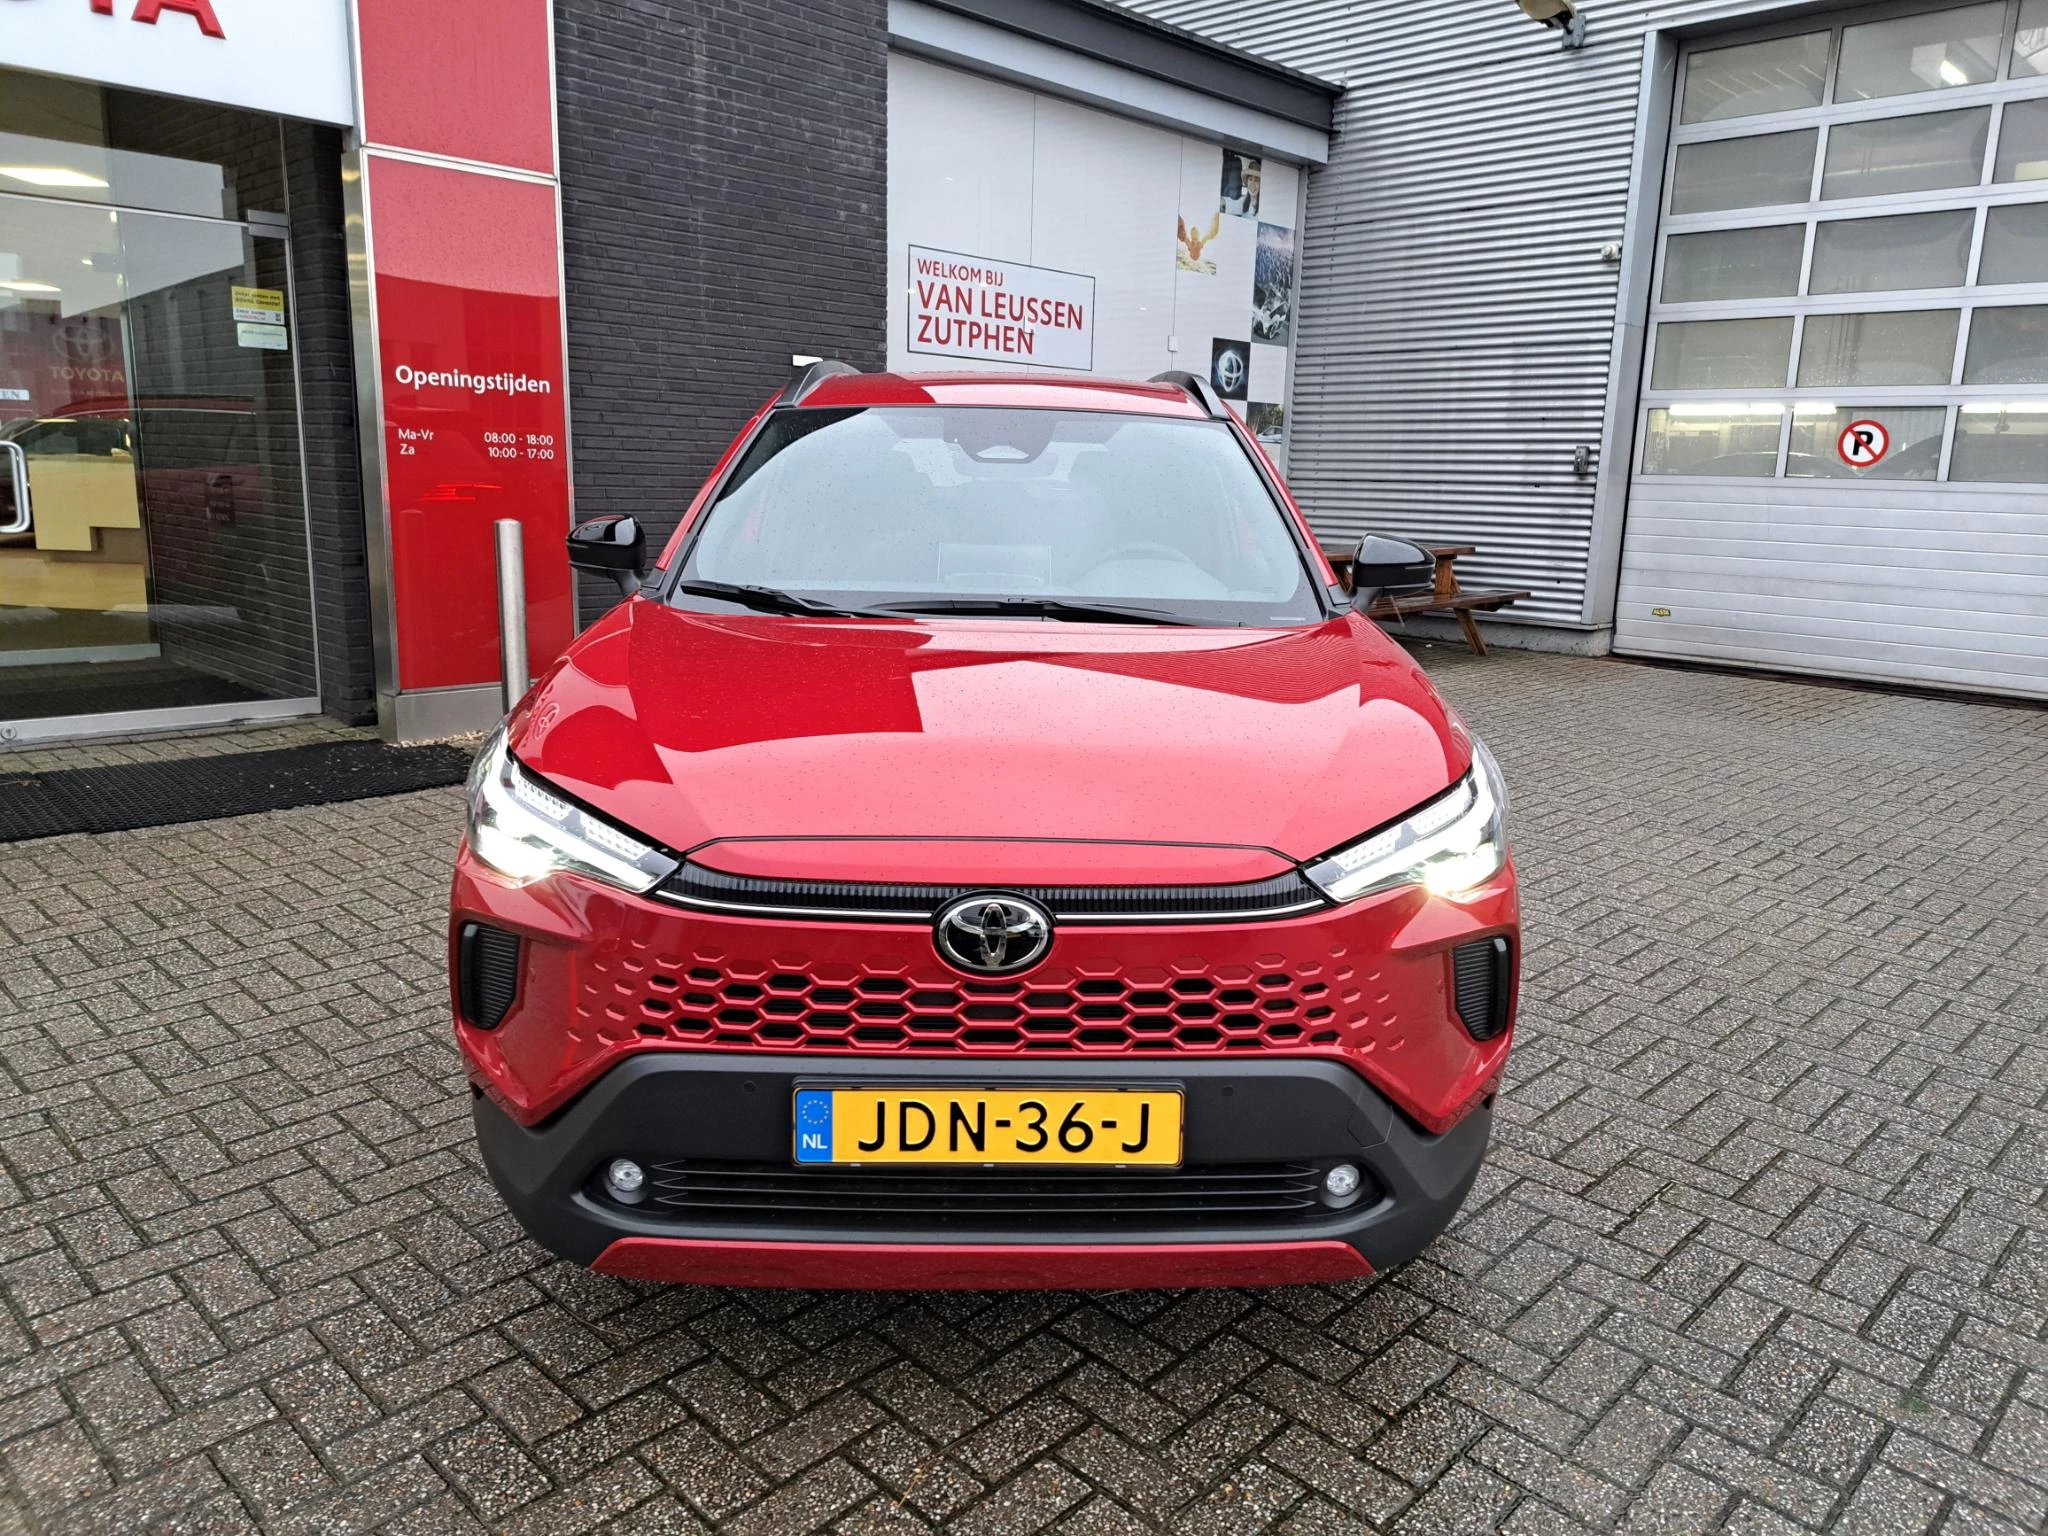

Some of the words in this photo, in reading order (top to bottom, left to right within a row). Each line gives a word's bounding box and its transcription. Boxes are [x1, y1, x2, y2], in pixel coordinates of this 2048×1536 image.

[917, 258, 982, 283] WELKOM
[986, 270, 1004, 287] BIJ
[917, 280, 972, 315] VAN
[981, 290, 1083, 330] LEUSSEN
[917, 314, 1033, 355] ZUTPHEN
[49, 366, 125, 383] TOYOTA
[395, 365, 550, 396] Openingstijden
[398, 428, 434, 441] Ma-Vr
[484, 432, 516, 444] 08:00
[526, 434, 554, 446] 18:00
[400, 443, 415, 455] Za
[488, 447, 517, 458] 10:00
[527, 449, 554, 460] 17:00
[802, 1133, 828, 1150] NL
[858, 1100, 1150, 1154] JDN-36-J
